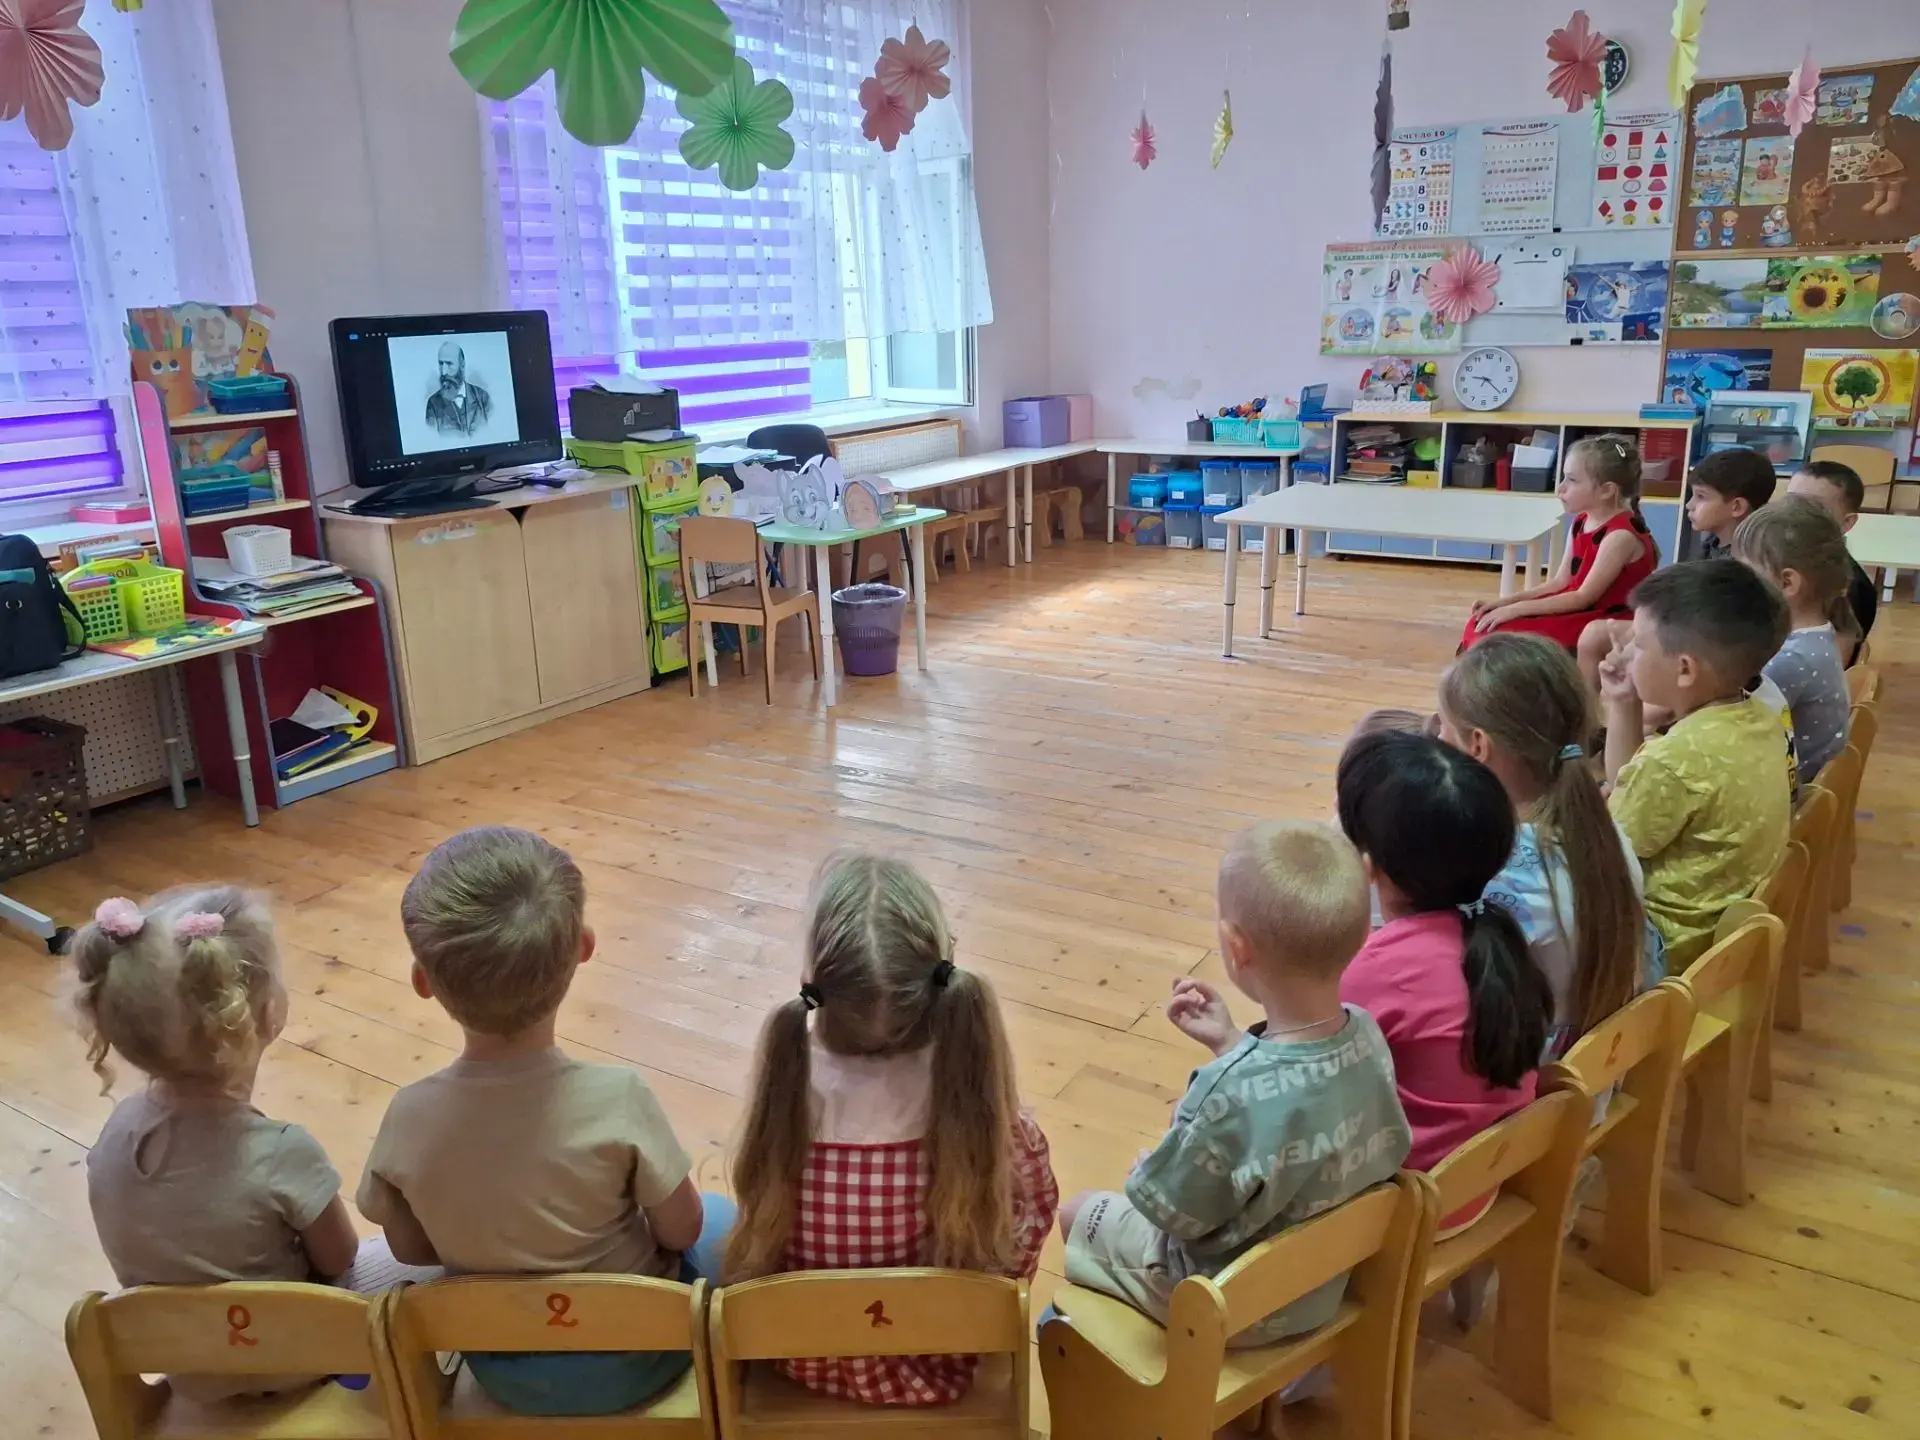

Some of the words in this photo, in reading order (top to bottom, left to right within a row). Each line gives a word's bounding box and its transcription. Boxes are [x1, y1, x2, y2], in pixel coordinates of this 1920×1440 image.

[1612, 59, 1623, 73] 3
[1420, 147, 1427, 157] 6
[1419, 166, 1427, 176] 7
[1418, 185, 1425, 195] 8
[1383, 205, 1391, 214] 4
[1417, 203, 1425, 213] 9
[1382, 224, 1389, 233] 5
[1417, 222, 1428, 231] 10
[546, 1293, 579, 1328] 2
